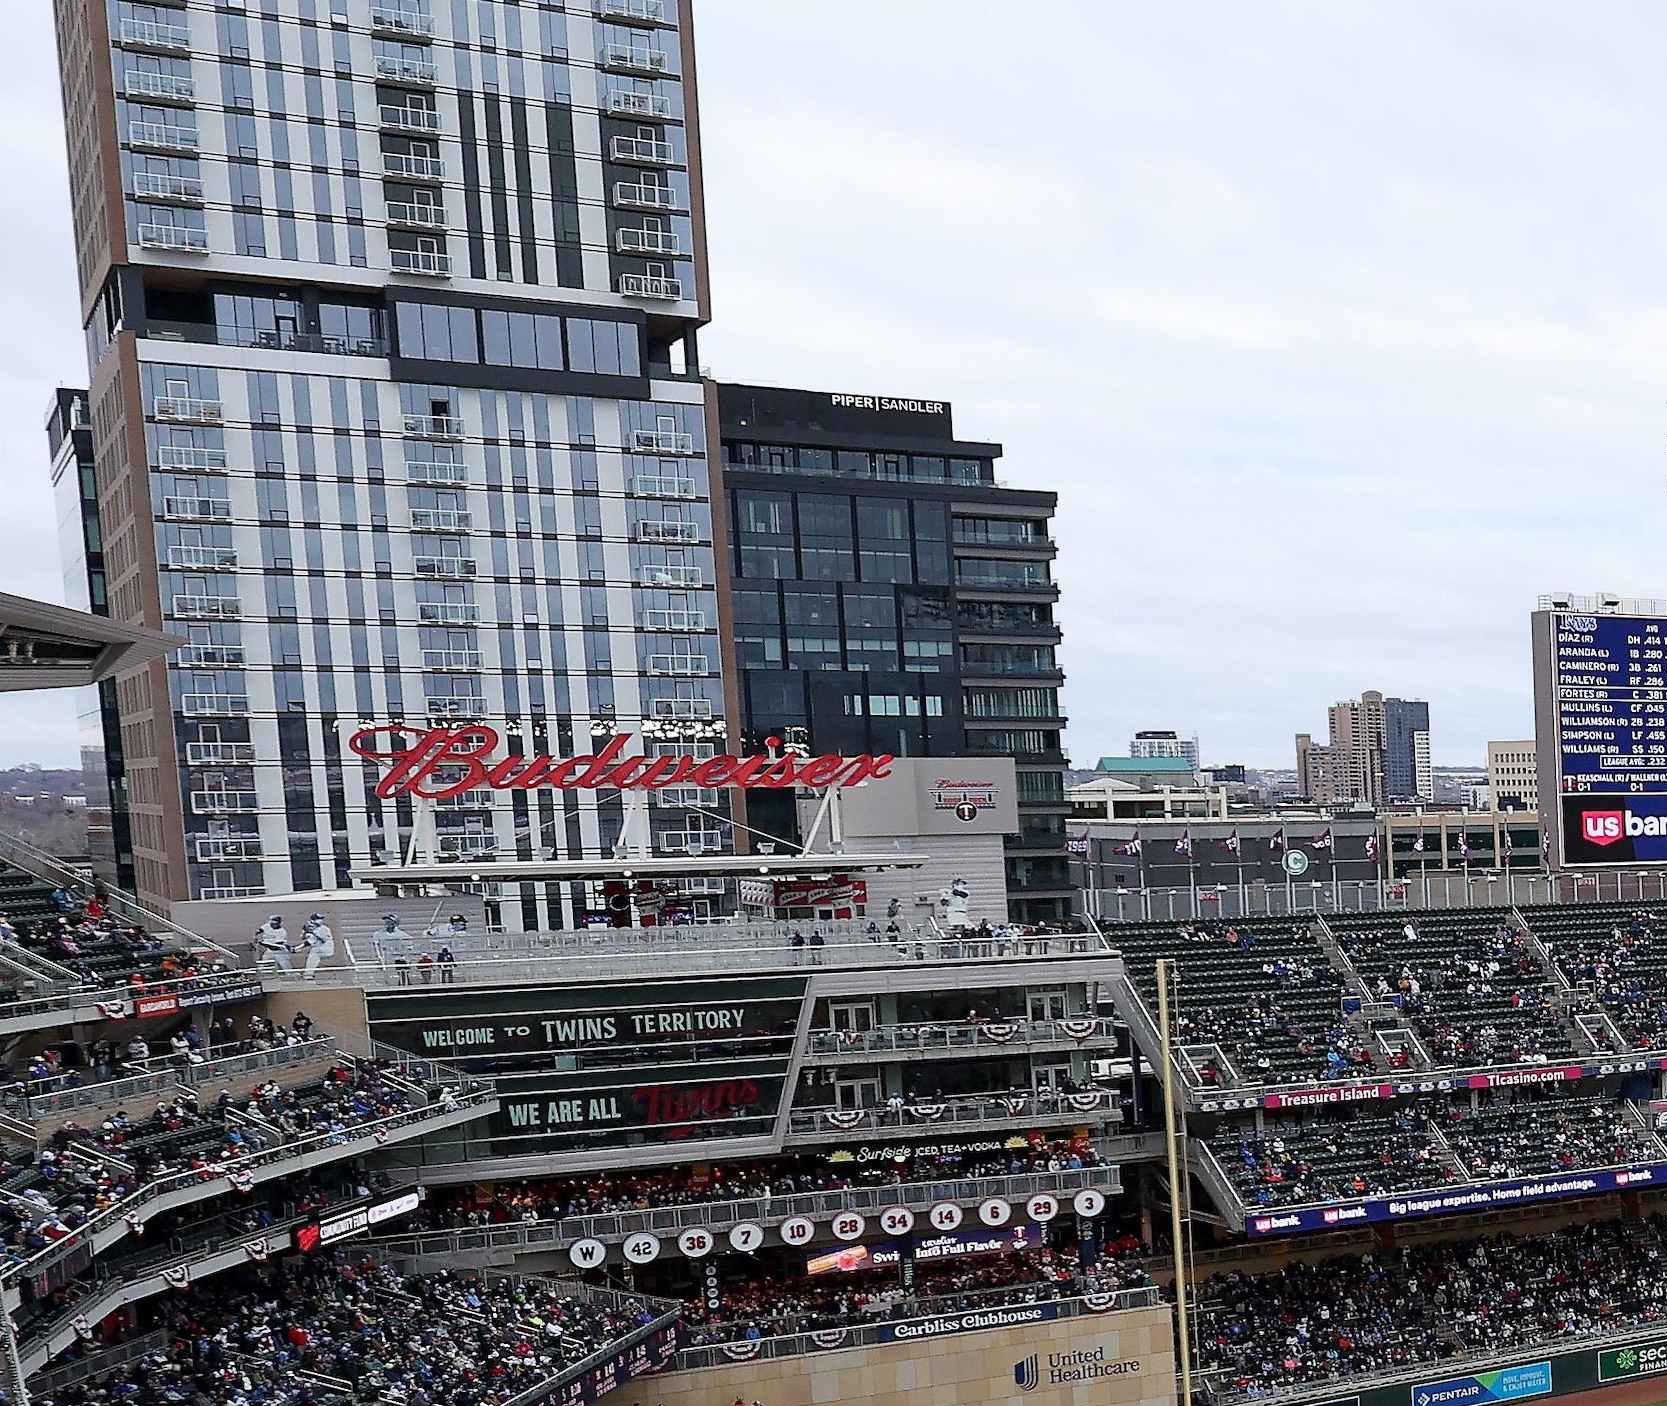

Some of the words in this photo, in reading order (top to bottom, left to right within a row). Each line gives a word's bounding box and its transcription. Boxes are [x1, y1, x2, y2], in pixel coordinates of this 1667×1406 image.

[832, 394, 874, 408] PIPER
[881, 398, 943, 414] SANDLER
[1559, 648, 1597, 657] ARANDA
[1559, 662, 1606, 671] CAMINERO
[1560, 675, 1595, 684] FRALEY
[1560, 689, 1595, 698] FORTES
[1561, 703, 1600, 712] MULLINS
[1561, 717, 1616, 726] WILLIAMSON
[1562, 731, 1602, 740] SIMPSON
[1562, 745, 1605, 754] WILLIAMS
[349, 724, 895, 799] Budweiser
[422, 1028, 495, 1048] WELCOME
[504, 1026, 530, 1037] TO
[541, 1017, 617, 1042] TWINS
[631, 1009, 745, 1034] TERRITORY
[1279, 1089, 1338, 1106] Treasure
[1340, 1086, 1380, 1102] Island
[508, 1102, 541, 1127] WE
[548, 1101, 583, 1124] ARE
[588, 1097, 621, 1120] ALL
[1033, 1202, 1051, 1214] 29
[1086, 1197, 1094, 1210] 3
[938, 1210, 954, 1223] 14
[990, 1206, 1000, 1218] 6
[839, 1219, 858, 1232] 28
[887, 1214, 908, 1228] 34
[741, 1230, 751, 1245] 7
[789, 1225, 806, 1238] 10
[632, 1241, 651, 1256] 42
[686, 1237, 706, 1251] 36
[579, 1246, 595, 1261] W
[894, 1320, 960, 1339] Carbliss
[962, 1307, 1043, 1329] Clubhouse
[1048, 1347, 1105, 1368] United
[1050, 1358, 1140, 1384] Healthcare
[1431, 1386, 1479, 1402] PENTAIR
